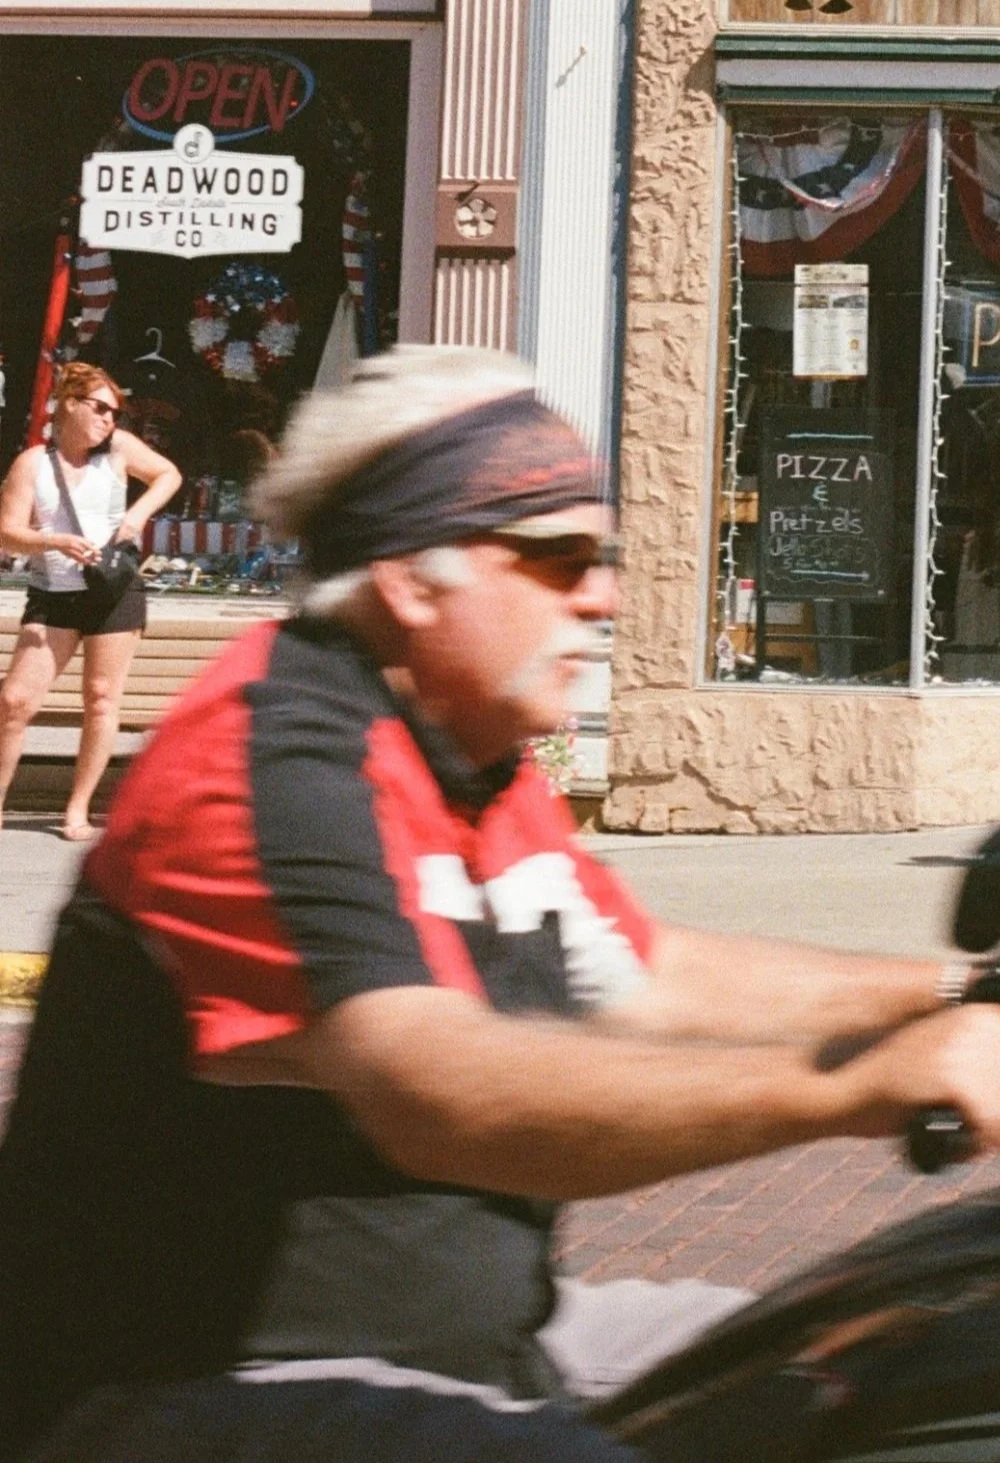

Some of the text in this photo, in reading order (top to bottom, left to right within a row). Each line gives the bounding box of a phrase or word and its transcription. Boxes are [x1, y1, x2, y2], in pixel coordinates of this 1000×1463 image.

[128, 58, 297, 131] OPEN
[97, 165, 289, 196] DEADWOOD
[104, 210, 278, 235] DISTILLING
[776, 453, 873, 482] PIZZA
[769, 510, 864, 535] Pretzels
